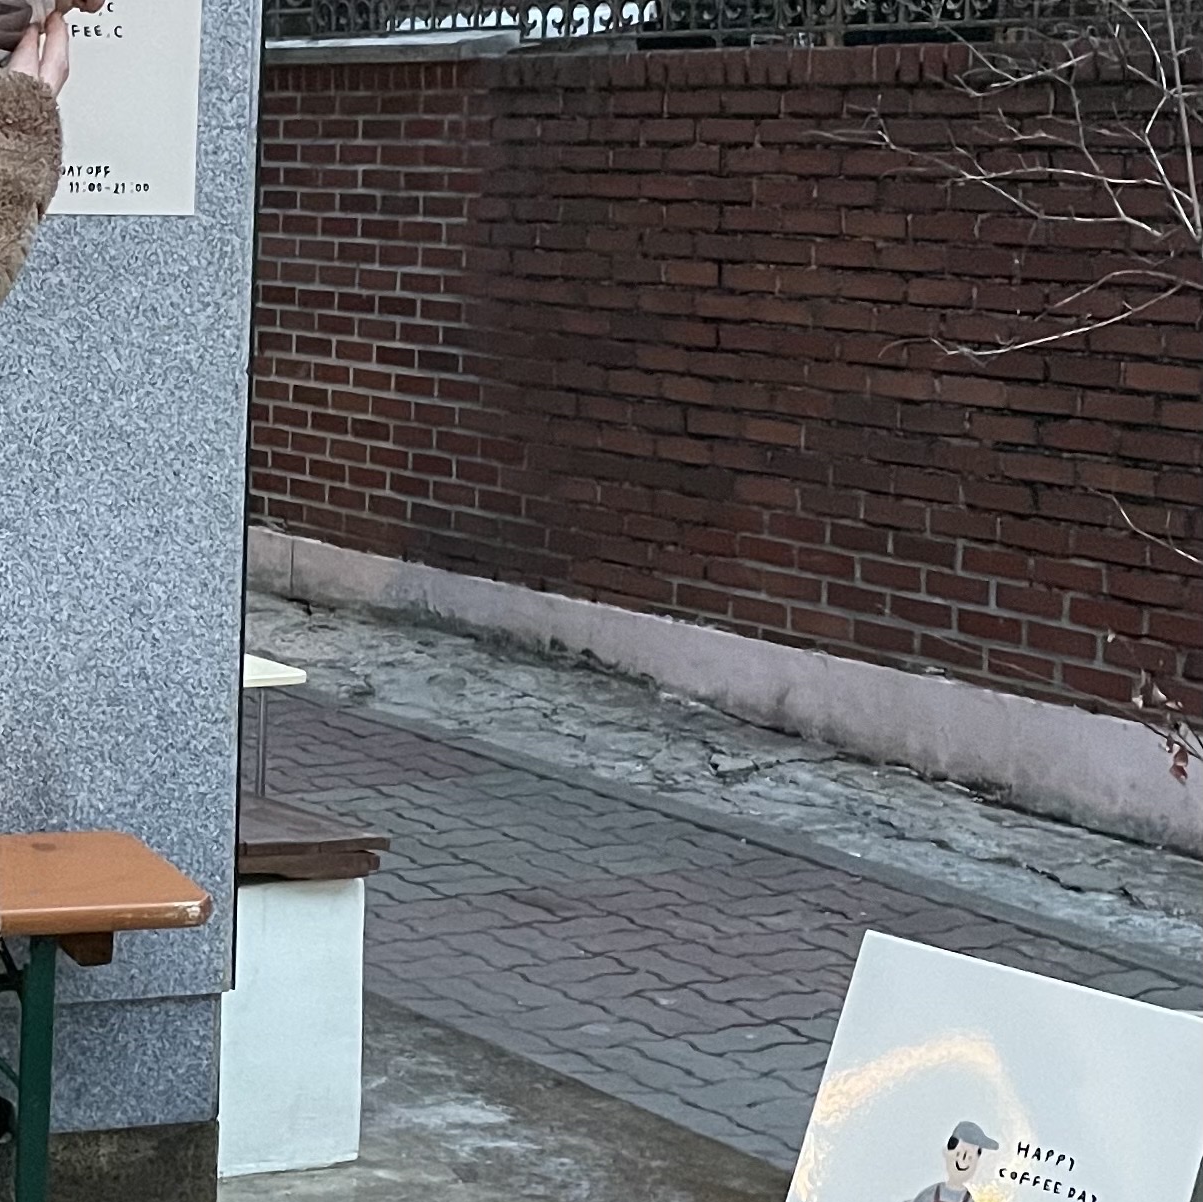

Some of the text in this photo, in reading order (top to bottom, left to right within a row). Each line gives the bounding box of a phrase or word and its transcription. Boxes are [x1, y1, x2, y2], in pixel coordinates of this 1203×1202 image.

[86, 165, 110, 178] OFF
[1017, 1141, 1075, 1171] HAPPY
[999, 1168, 1063, 1195] COFFEE
